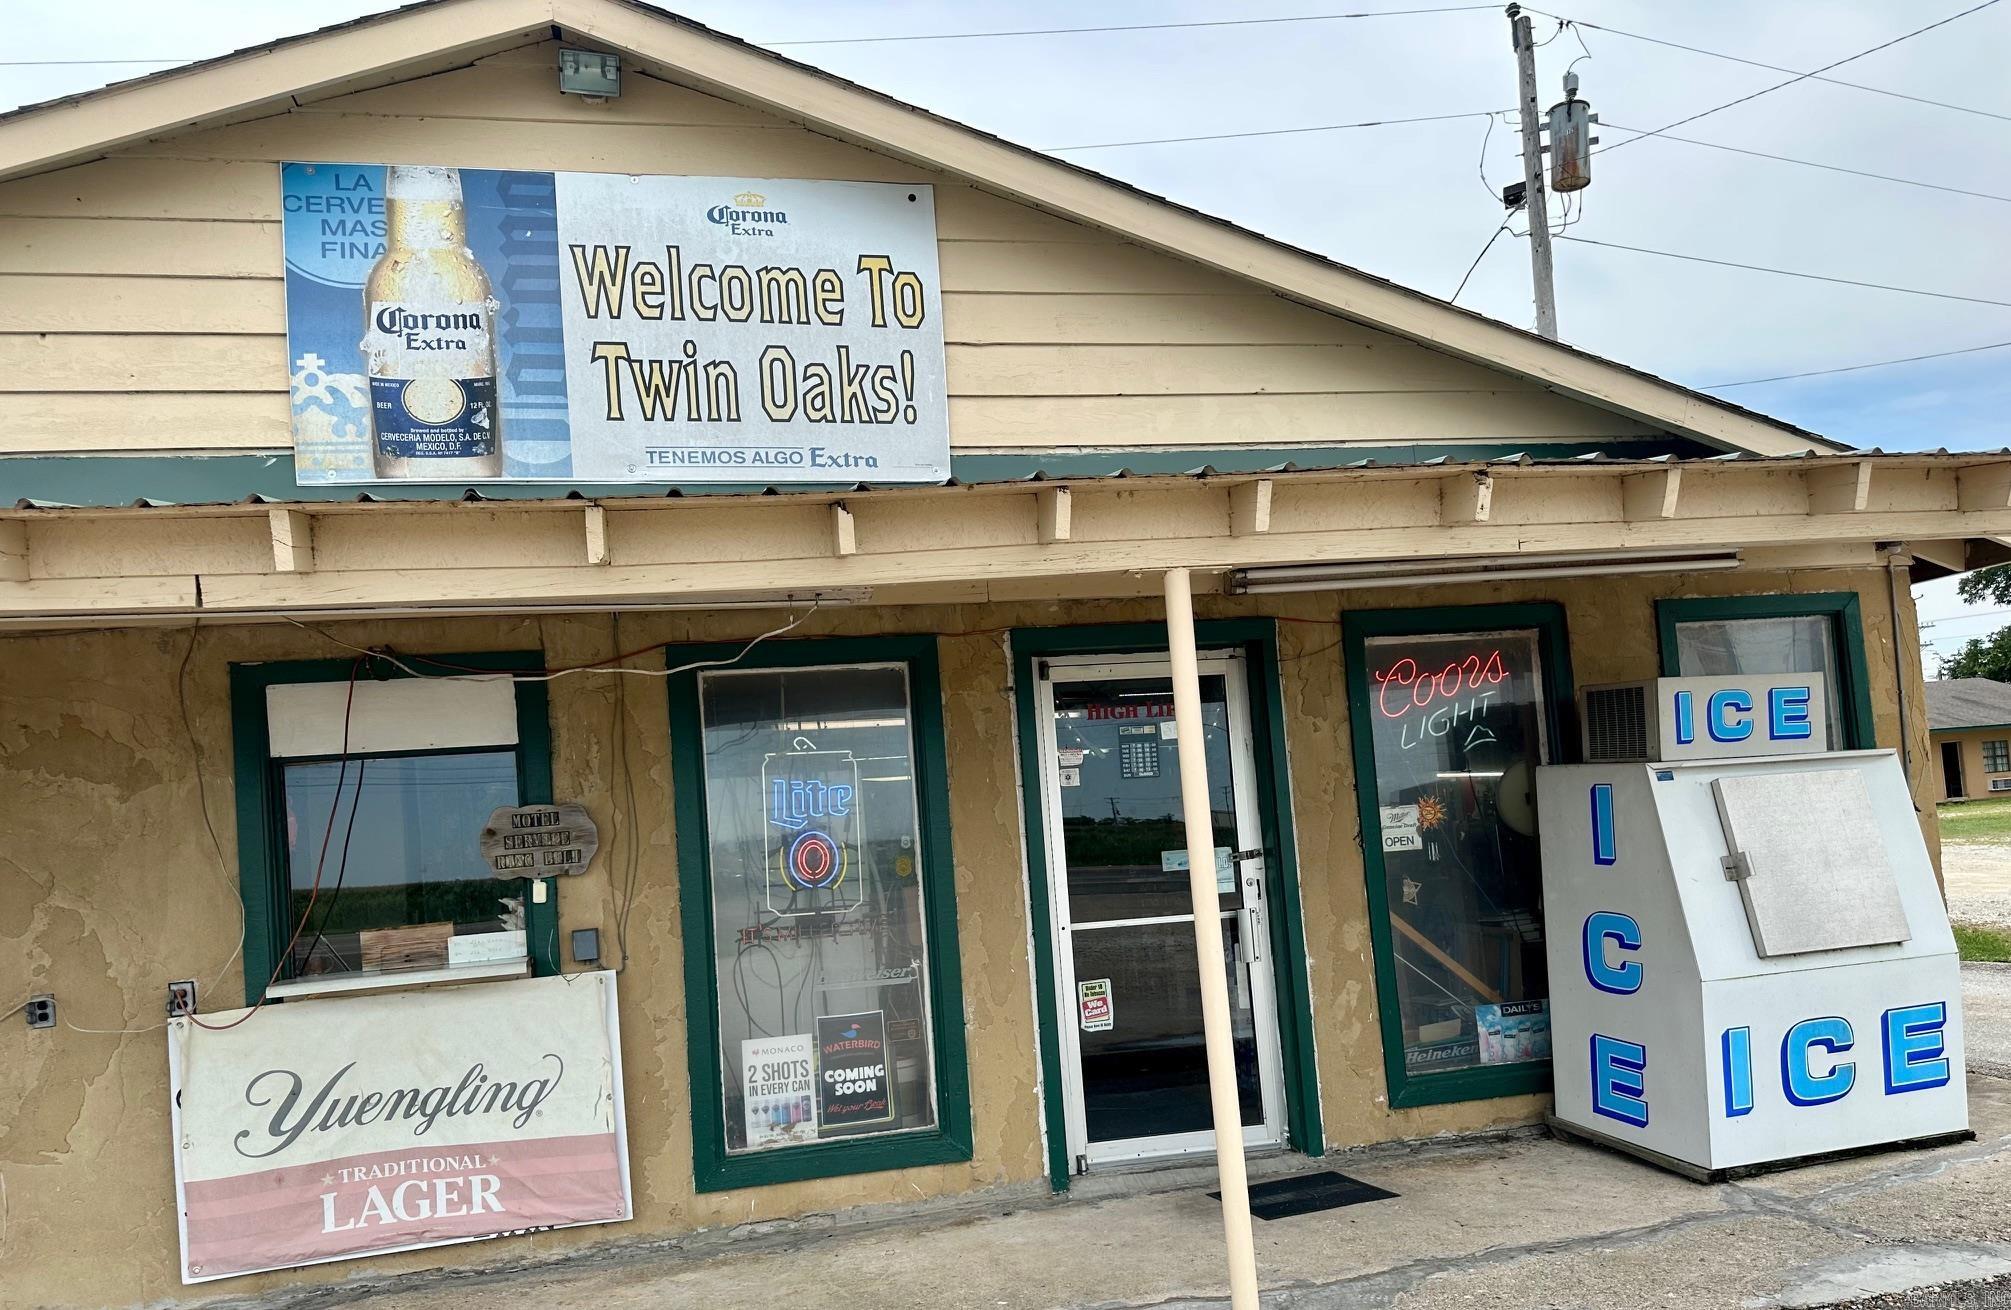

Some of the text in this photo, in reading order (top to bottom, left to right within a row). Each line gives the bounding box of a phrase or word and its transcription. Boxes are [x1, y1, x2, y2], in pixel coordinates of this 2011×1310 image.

[334, 173, 374, 192] LA
[283, 194, 386, 215] CERVE
[706, 204, 788, 227] Corona
[320, 218, 388, 238] MAS
[730, 223, 774, 237] Extra
[321, 241, 387, 260] FINA
[568, 244, 926, 329] Welcome To
[375, 306, 483, 338] Corona
[405, 332, 467, 351] Extra
[590, 339, 918, 425] Twin Oaks!
[376, 401, 393, 410] BEER
[380, 431, 422, 442] CERVECERIA
[422, 432, 458, 443] MODELO,
[459, 432, 472, 441] S.A.
[473, 432, 481, 440] DE
[415, 442, 462, 452] MEXICO, D.F.
[645, 447, 880, 469] TENEMOS ALGO Extra
[1375, 650, 1511, 718] Coors
[1401, 690, 1497, 751] LIGHT
[1675, 685, 1812, 744] ICE
[769, 779, 853, 830] Lite
[511, 811, 560, 829] MOTEL
[1384, 835, 1415, 848] OPEN
[1582, 782, 1650, 1129] ICE
[1084, 1004, 1108, 1017] Card
[1086, 1000, 1104, 1009] We
[761, 1044, 805, 1056] MONACO
[822, 1039, 881, 1055] WATERBIRD
[1721, 1000, 1951, 1119] ICE
[747, 1059, 810, 1084] 2 SHOTS
[824, 1063, 886, 1083] COMING
[748, 1078, 811, 1097] IN EVERY CAN
[834, 1078, 878, 1096] SOON
[233, 1053, 565, 1159] Yuengling
[337, 1154, 487, 1184] TRADITIONAL
[319, 1173, 507, 1234] LAGER
